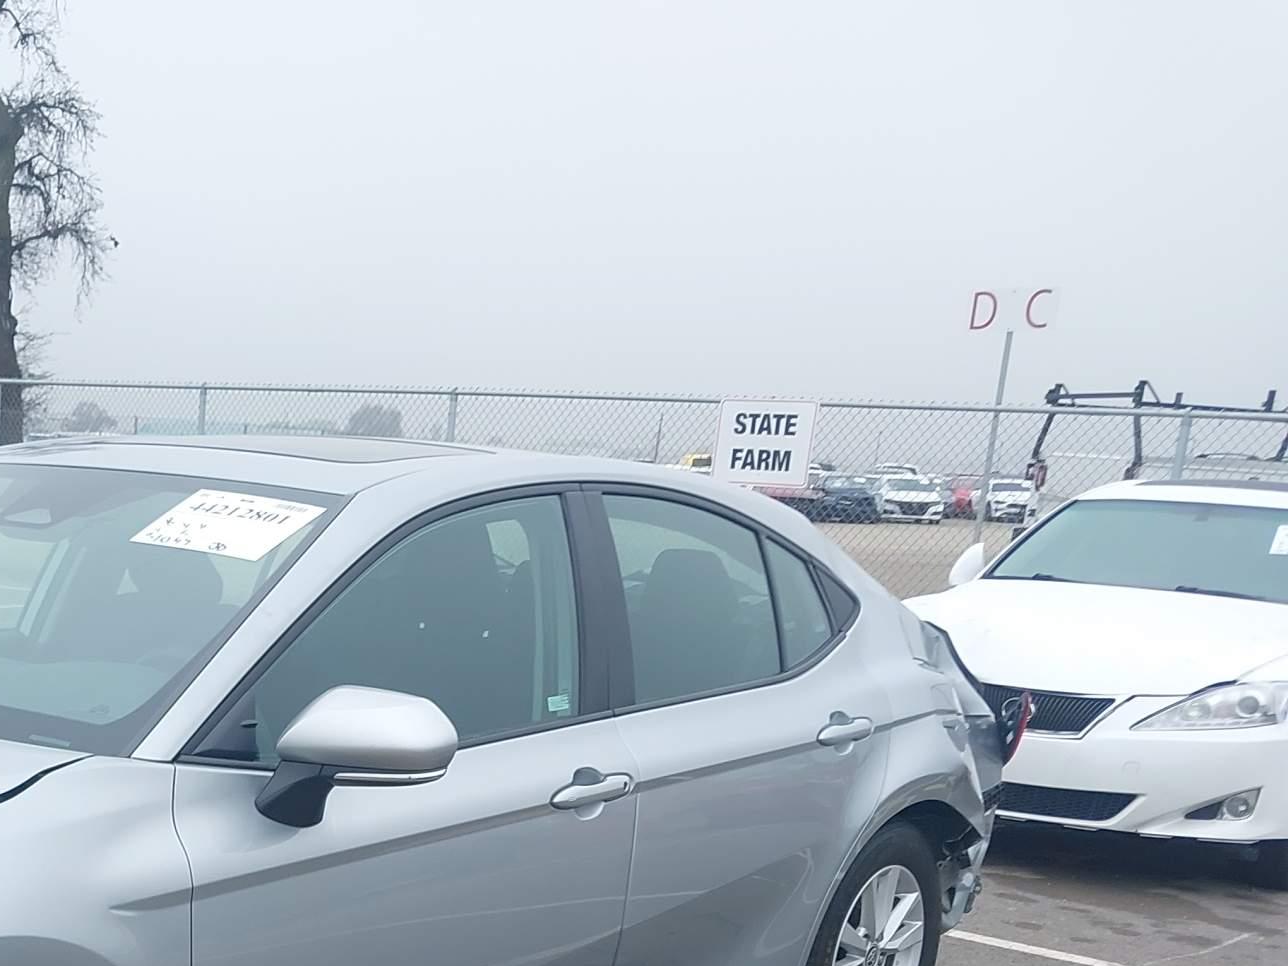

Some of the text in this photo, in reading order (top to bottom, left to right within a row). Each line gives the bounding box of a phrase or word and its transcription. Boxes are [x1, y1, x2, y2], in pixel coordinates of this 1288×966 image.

[969, 288, 1053, 330] D C
[733, 412, 798, 436] STATE
[730, 448, 792, 472] FARM
[189, 502, 293, 525] 44212801
